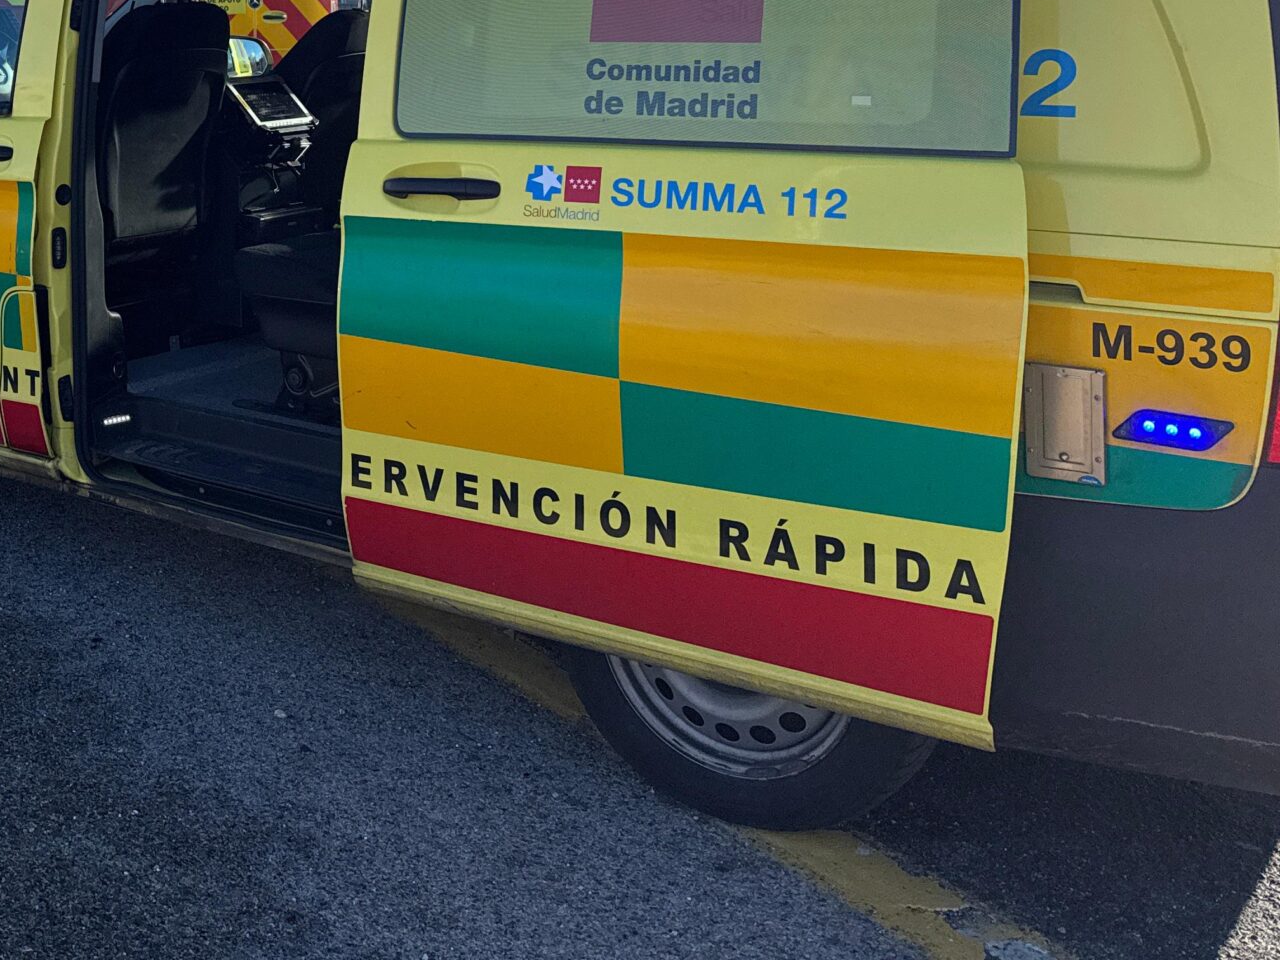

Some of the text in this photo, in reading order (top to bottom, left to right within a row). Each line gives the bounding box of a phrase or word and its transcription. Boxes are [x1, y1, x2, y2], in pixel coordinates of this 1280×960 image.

[586, 58, 761, 84] Comunidad
[583, 89, 758, 120] de Madrid
[523, 204, 600, 222] SaludMadrid
[610, 177, 848, 219] SUMMA 112
[1092, 322, 1252, 373] M-939
[350, 452, 986, 606] ERVENCIÓN RÁPIDA
